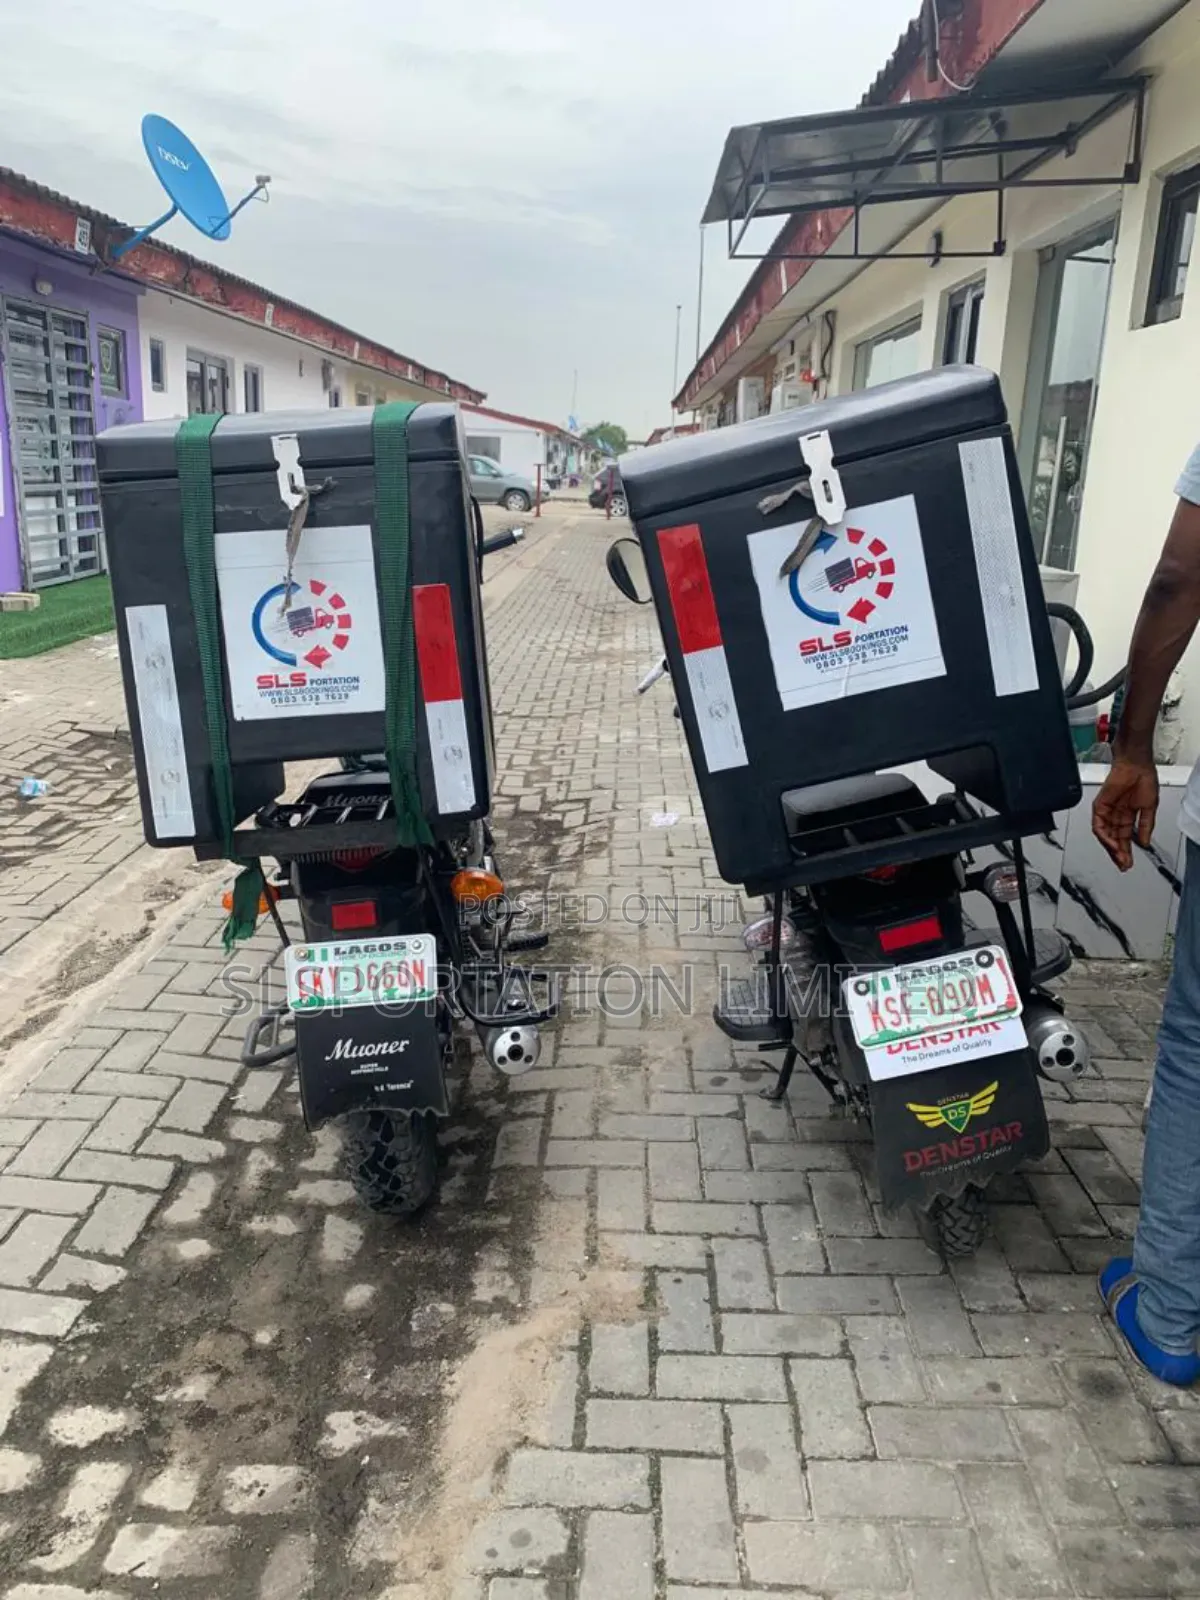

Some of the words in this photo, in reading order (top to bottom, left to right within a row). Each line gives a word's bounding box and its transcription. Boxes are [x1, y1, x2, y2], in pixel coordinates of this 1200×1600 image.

[799, 630, 852, 657] SLS
[854, 624, 909, 643] PORTATION
[256, 672, 307, 690] SLS
[309, 676, 360, 687] PORTATION
[334, 942, 407, 957] LAGOS
[894, 957, 974, 982] LAGOS
[324, 1038, 410, 1061] Muoner
[902, 1054, 917, 1063] The
[918, 1048, 951, 1061] Dreams
[952, 1044, 961, 1053] of
[962, 1039, 993, 1053] Quality
[948, 1106, 967, 1120] DS
[904, 1121, 1023, 1173] DENSTAR
